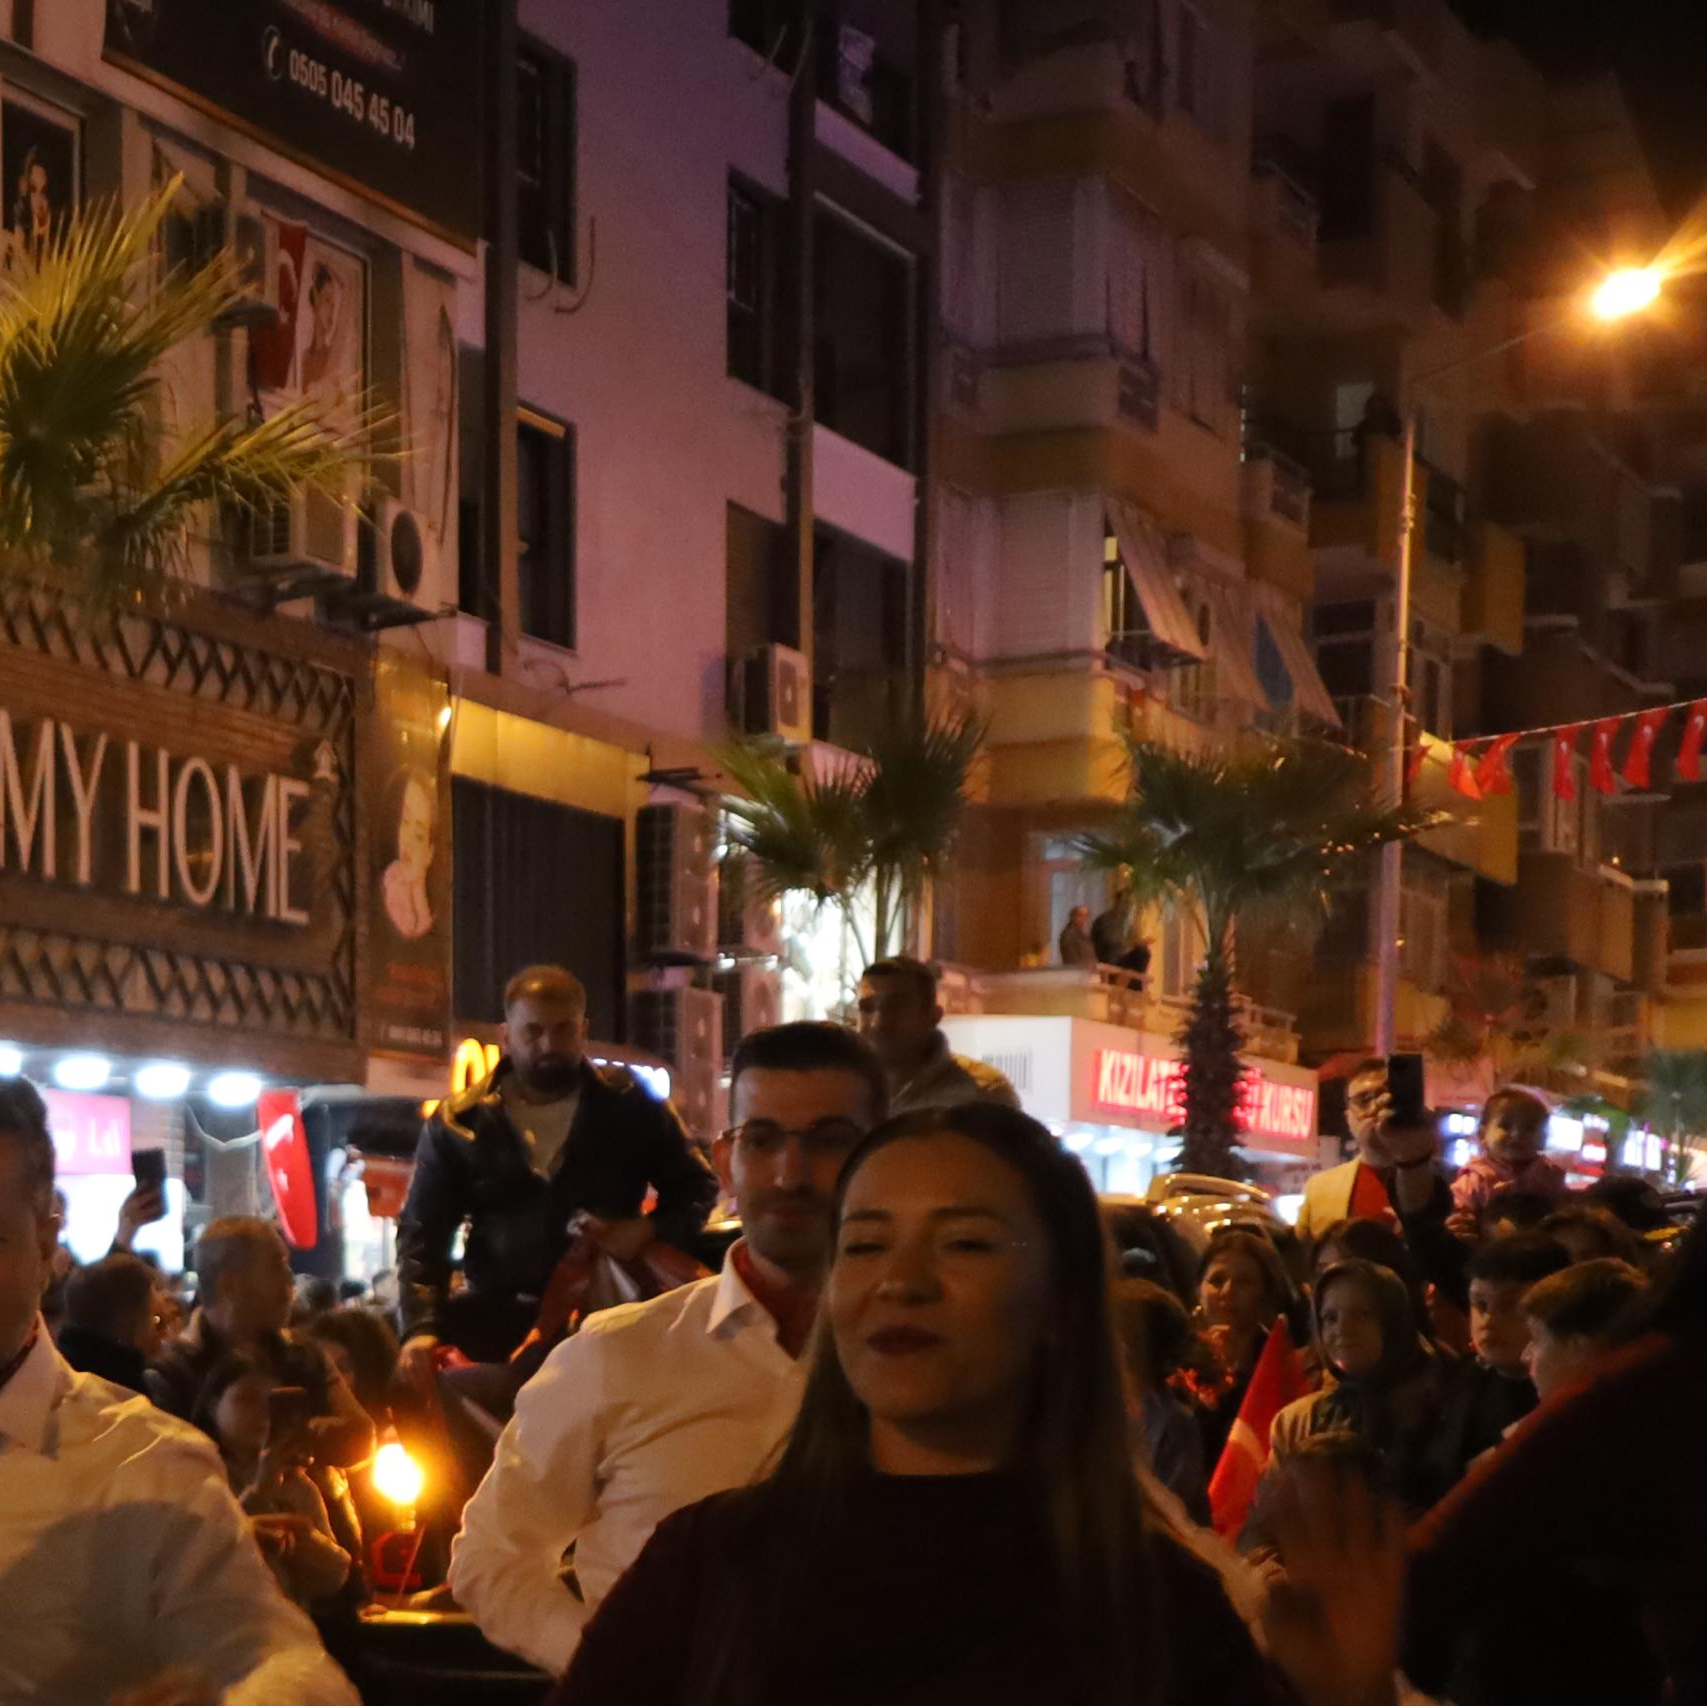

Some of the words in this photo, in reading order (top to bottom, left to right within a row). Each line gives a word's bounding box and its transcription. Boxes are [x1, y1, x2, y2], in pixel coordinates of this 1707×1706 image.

[289, 48, 327, 96] 0505
[331, 69, 364, 122] 045
[369, 92, 390, 135] 45
[393, 105, 416, 150] 04
[126, 740, 310, 926] HOME
[1259, 1080, 1314, 1139] KURSU
